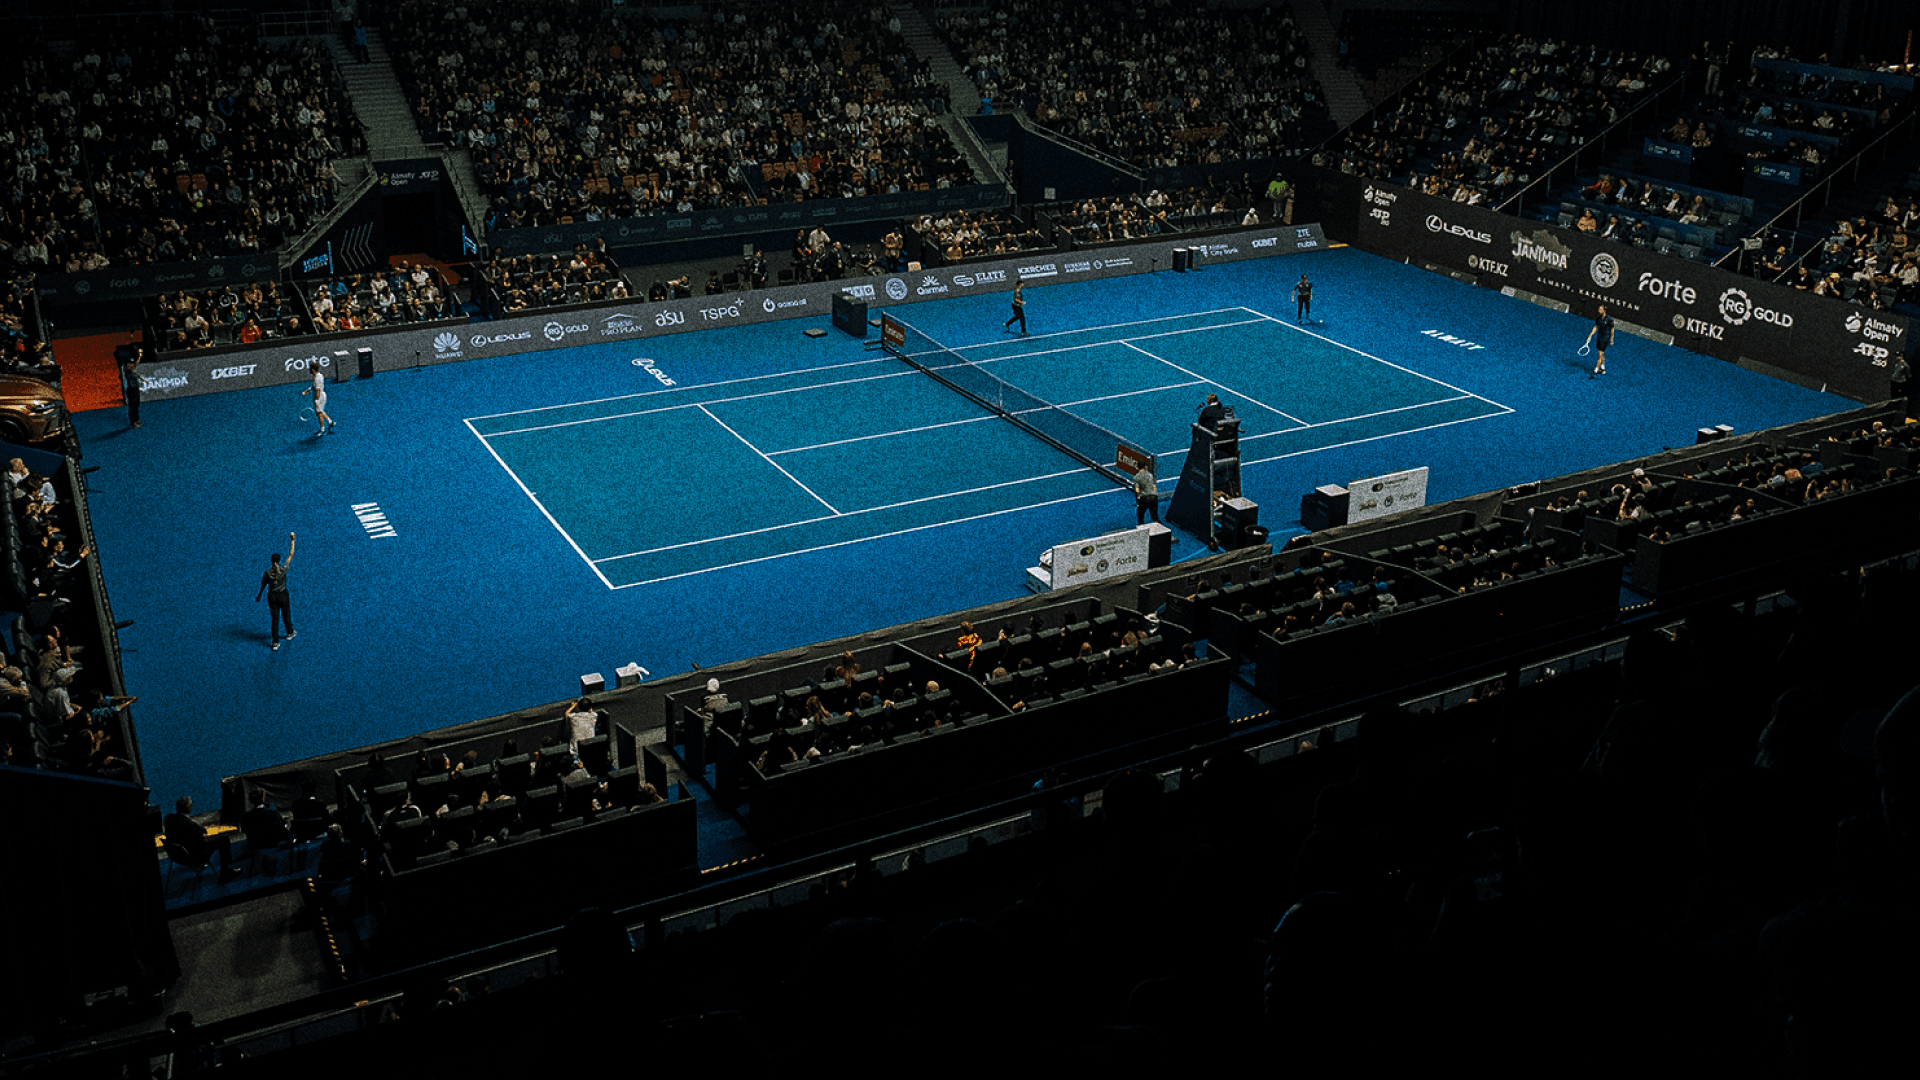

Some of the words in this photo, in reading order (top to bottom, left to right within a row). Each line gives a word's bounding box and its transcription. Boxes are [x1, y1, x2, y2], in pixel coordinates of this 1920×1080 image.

[1442, 222, 1492, 244] LEXUS
[1511, 241, 1568, 269] JANYMDA
[1638, 272, 1698, 304] Forte
[1725, 298, 1745, 315] RG
[1753, 306, 1794, 328] GOLD
[1686, 316, 1725, 341] KTF.KZ
[1862, 326, 1890, 343] Open
[1864, 317, 1904, 338] Almaty
[210, 363, 258, 380] 1XBET
[350, 501, 399, 540] ALMATY
